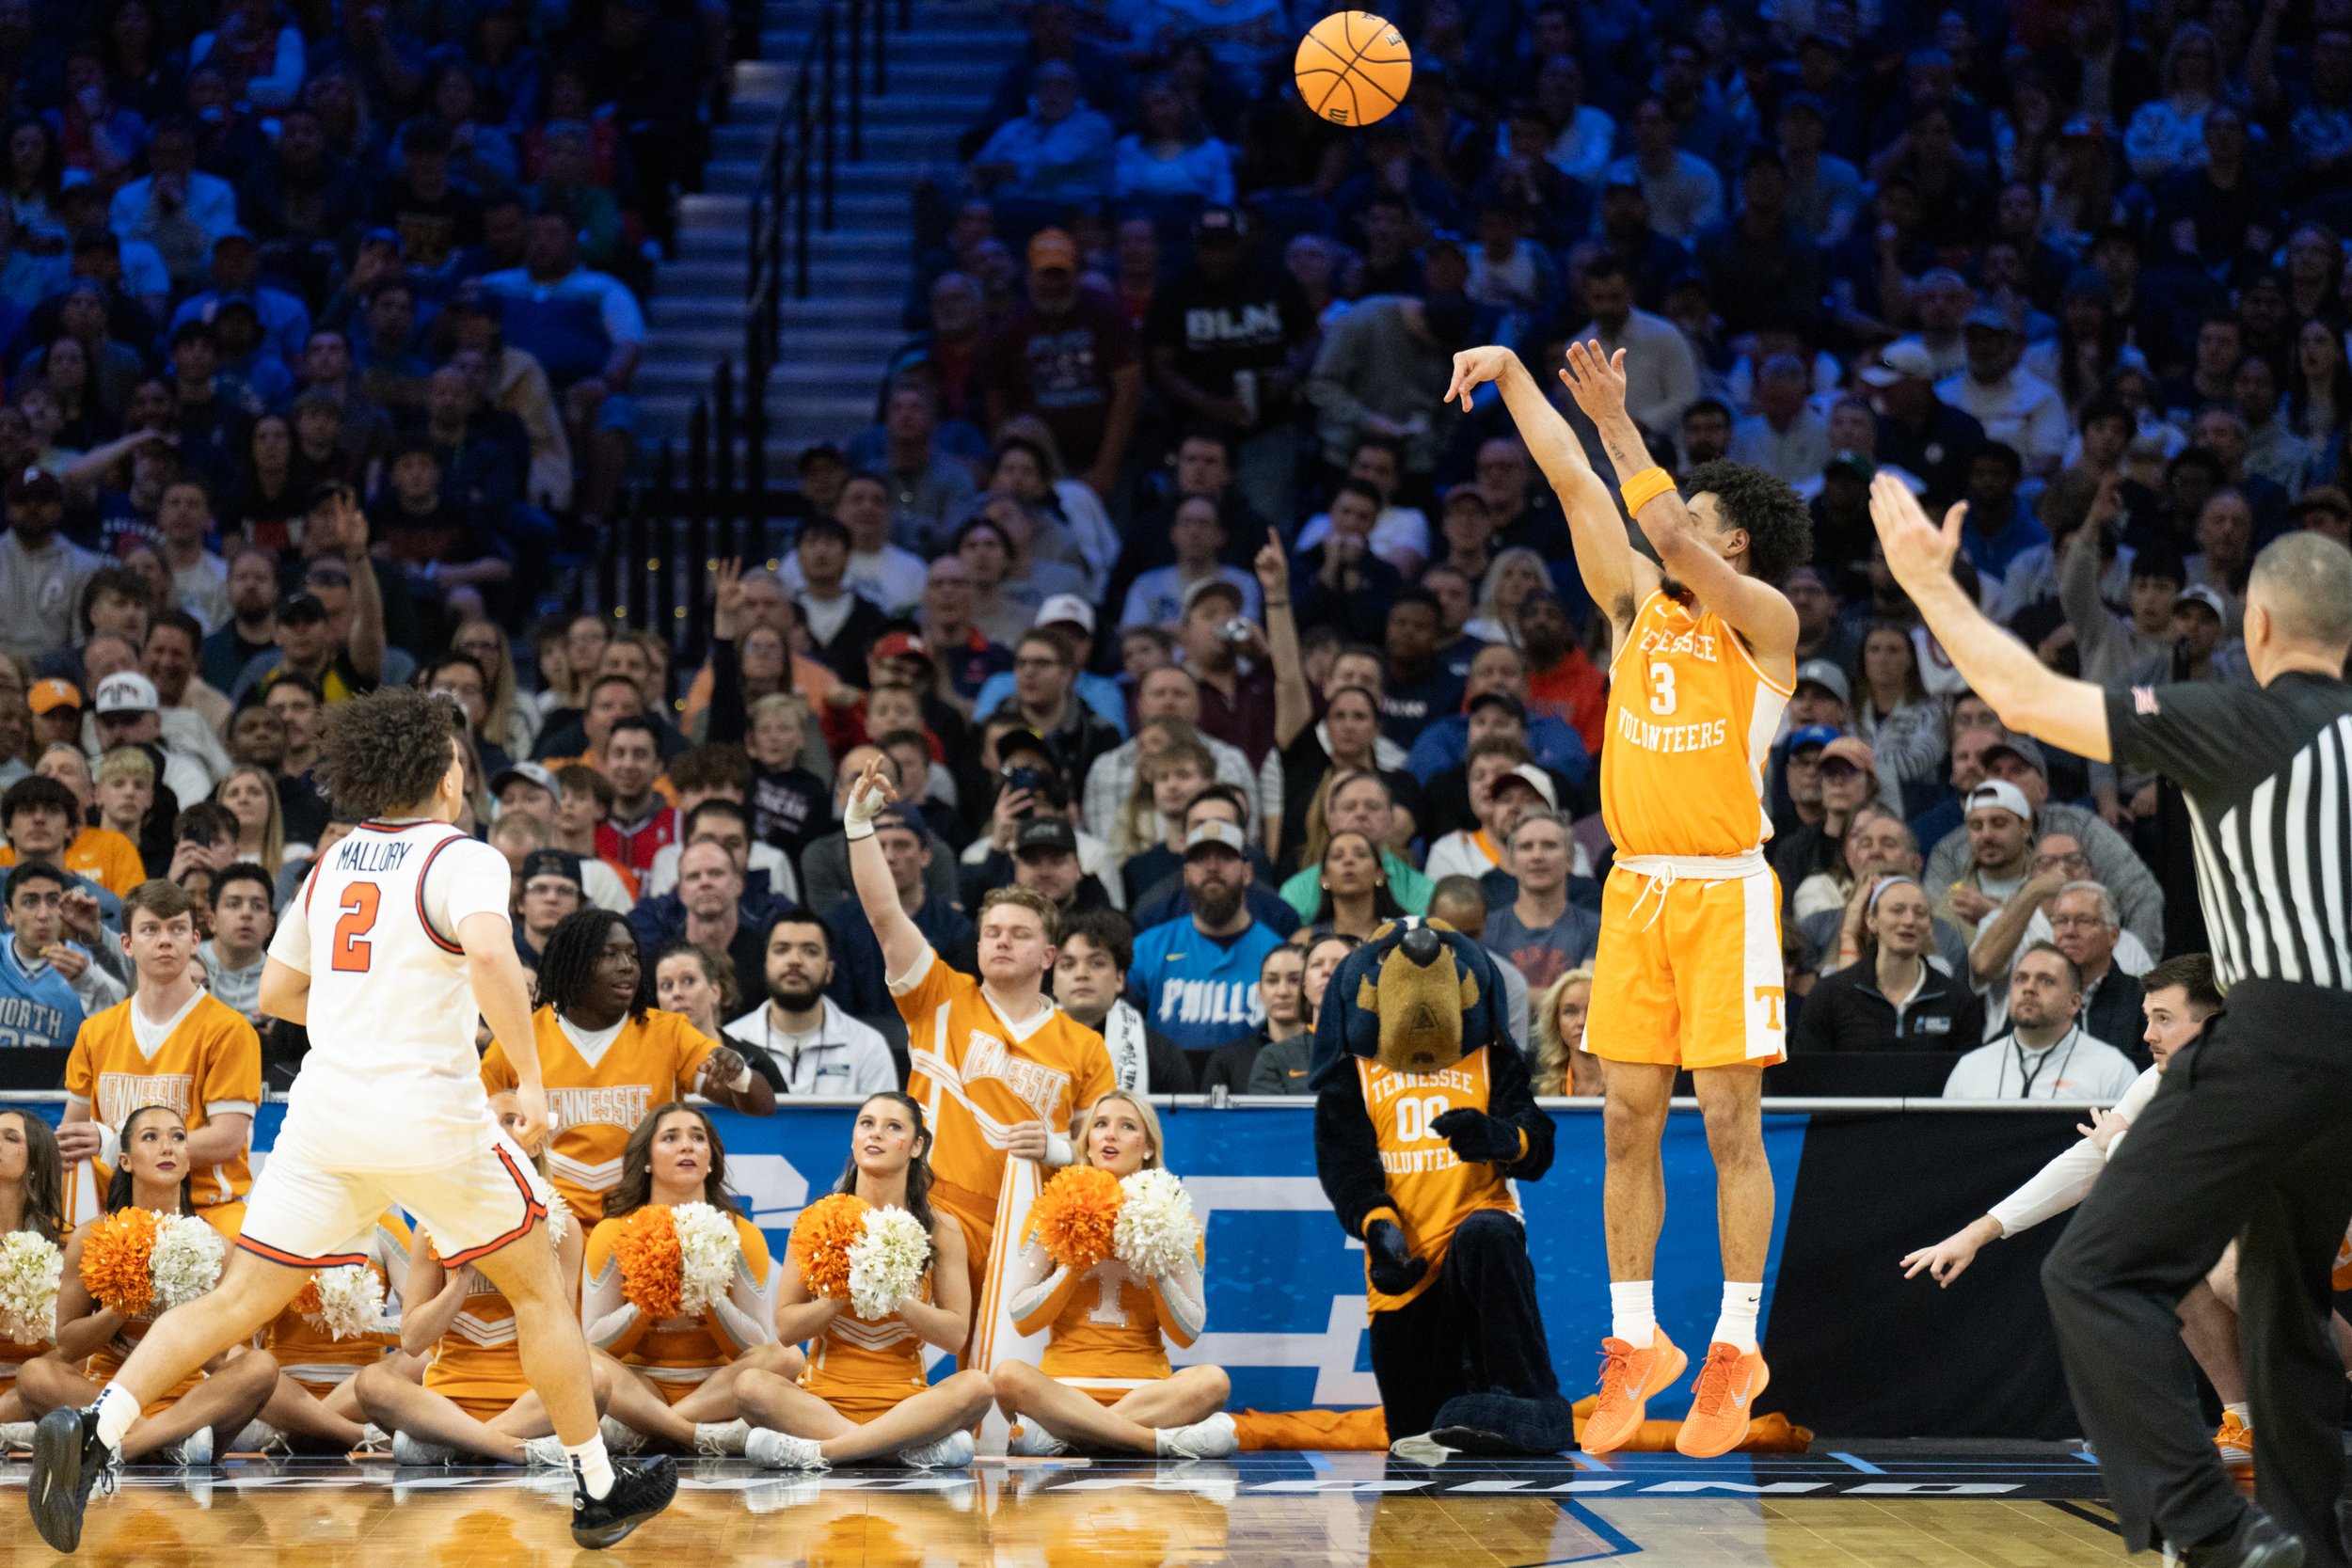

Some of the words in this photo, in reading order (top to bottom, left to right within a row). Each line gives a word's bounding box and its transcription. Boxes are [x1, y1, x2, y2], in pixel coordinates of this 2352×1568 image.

[1649, 661, 1677, 716] 3
[1618, 705, 1727, 752] VOLUNTEERS
[336, 841, 413, 872] MALLORY
[331, 881, 381, 973] 2
[1754, 985, 1785, 1031] T
[1372, 1069, 1473, 1103] TENNESSEE
[545, 1085, 652, 1139] ENNESSEE
[1396, 1095, 1449, 1143] 00
[1080, 1259, 1151, 1326] T
